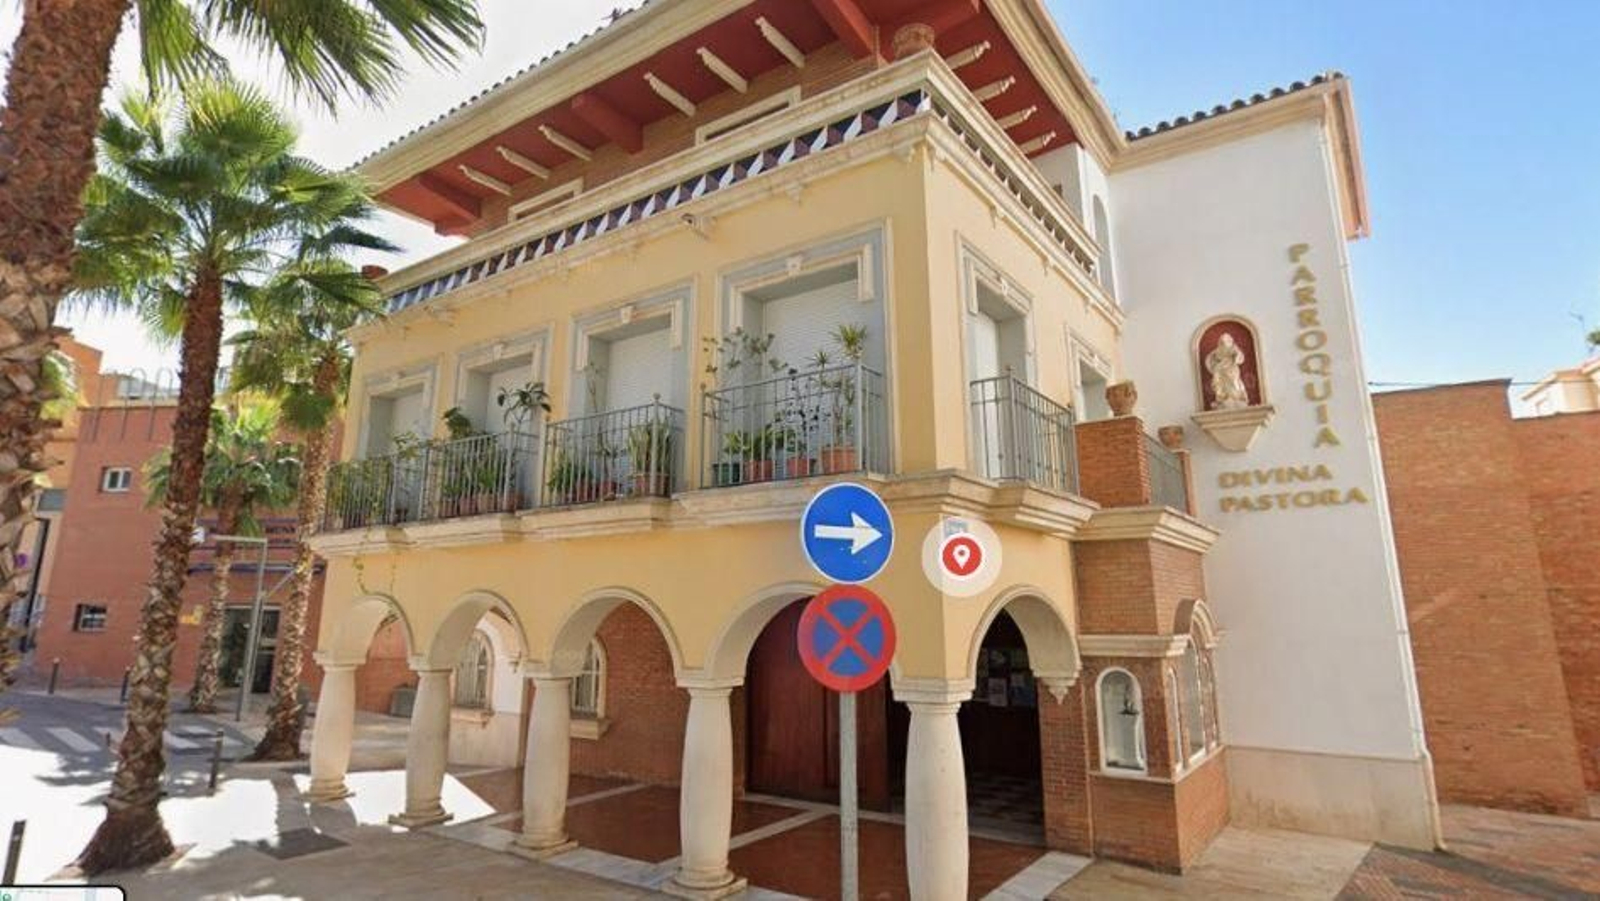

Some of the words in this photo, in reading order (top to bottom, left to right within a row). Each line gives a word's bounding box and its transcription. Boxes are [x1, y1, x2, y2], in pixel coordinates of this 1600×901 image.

[1287, 243, 1340, 448] PARROQUIA
[1218, 464, 1333, 488] DIVINA
[1220, 487, 1368, 513] PASTORA
